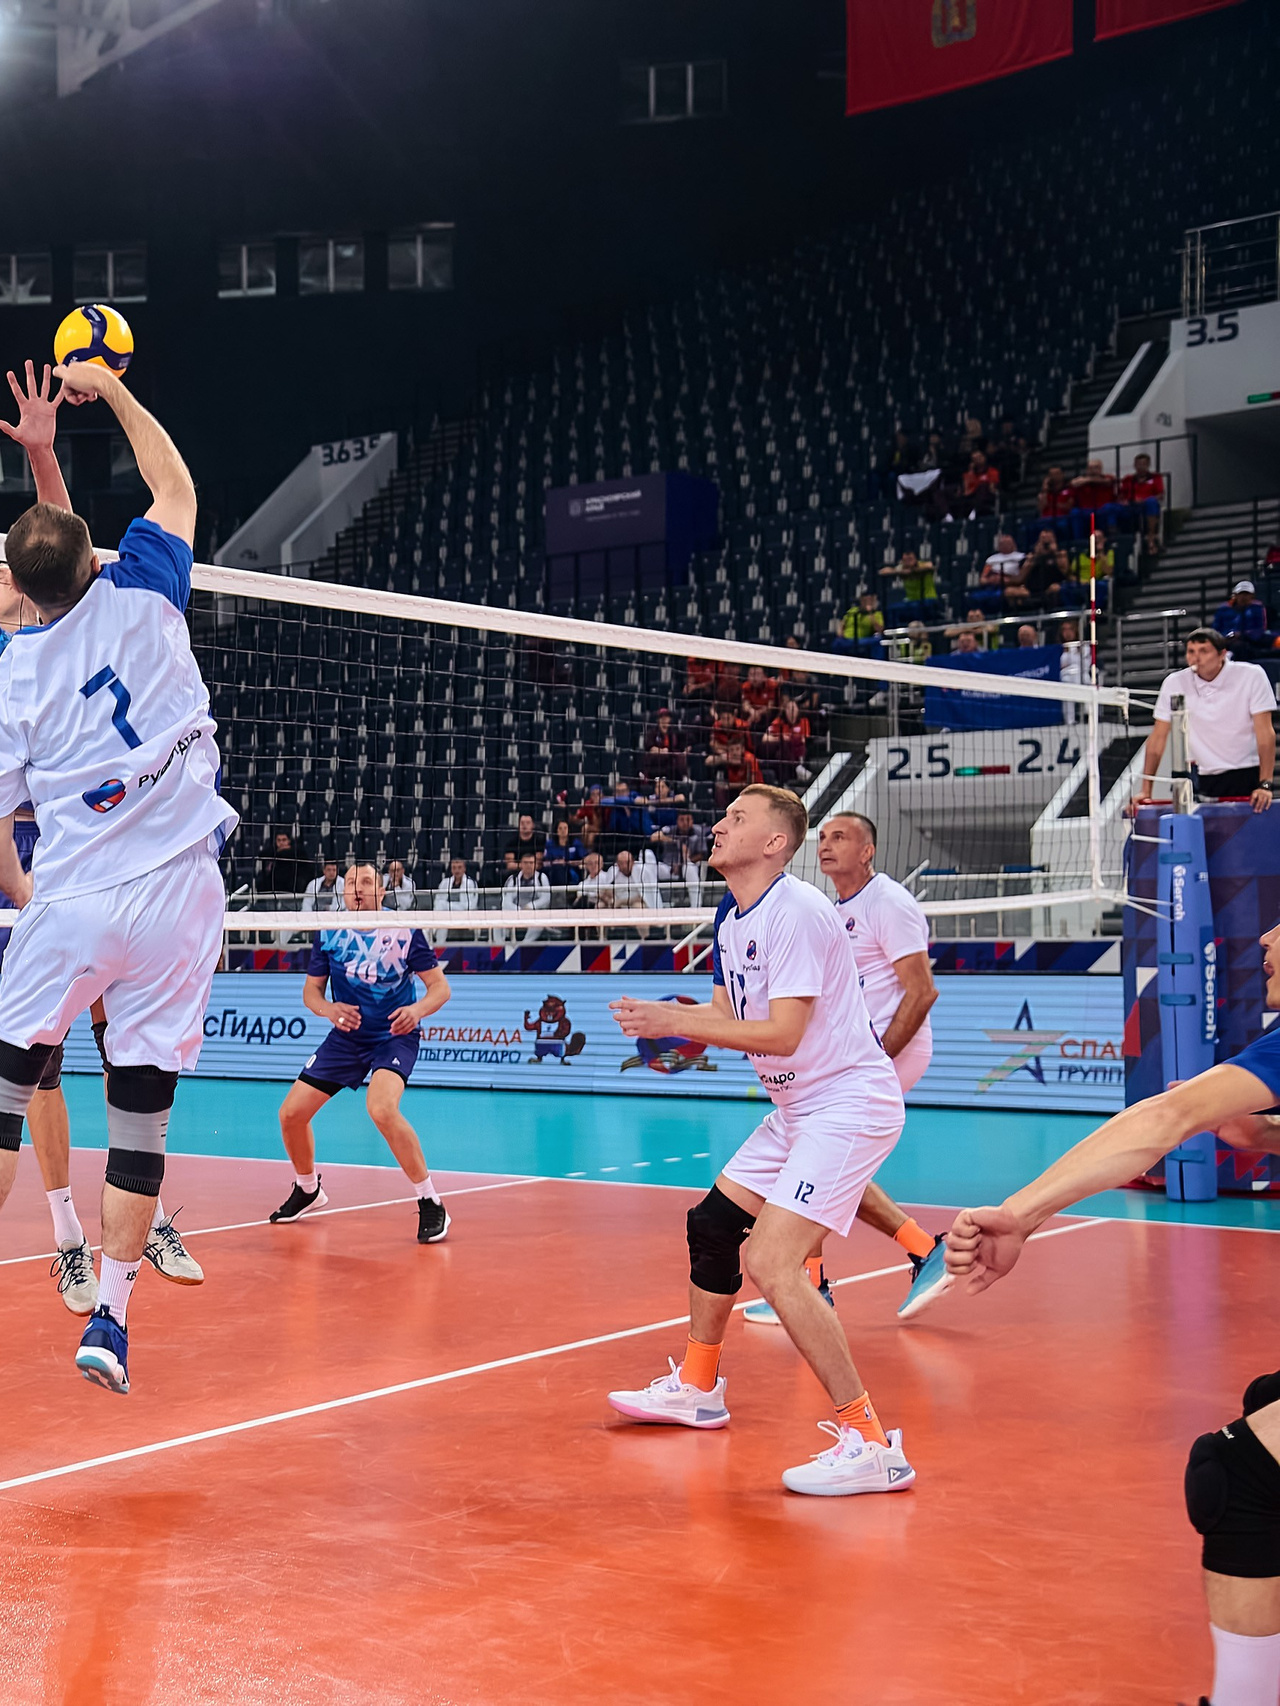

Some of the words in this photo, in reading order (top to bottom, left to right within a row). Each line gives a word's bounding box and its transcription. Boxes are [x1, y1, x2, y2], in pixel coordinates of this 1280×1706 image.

[1186, 311, 1239, 347] 3.5
[78, 664, 144, 750] 7
[887, 743, 951, 780] 2.5
[1018, 738, 1081, 773] 2.4
[1204, 963, 1218, 1040] Senoh
[305, 1053, 317, 1069] 0
[443, 1048, 522, 1065] РУСГИДРО
[1060, 1039, 1124, 1060] СПА
[794, 1180, 815, 1204] 12
